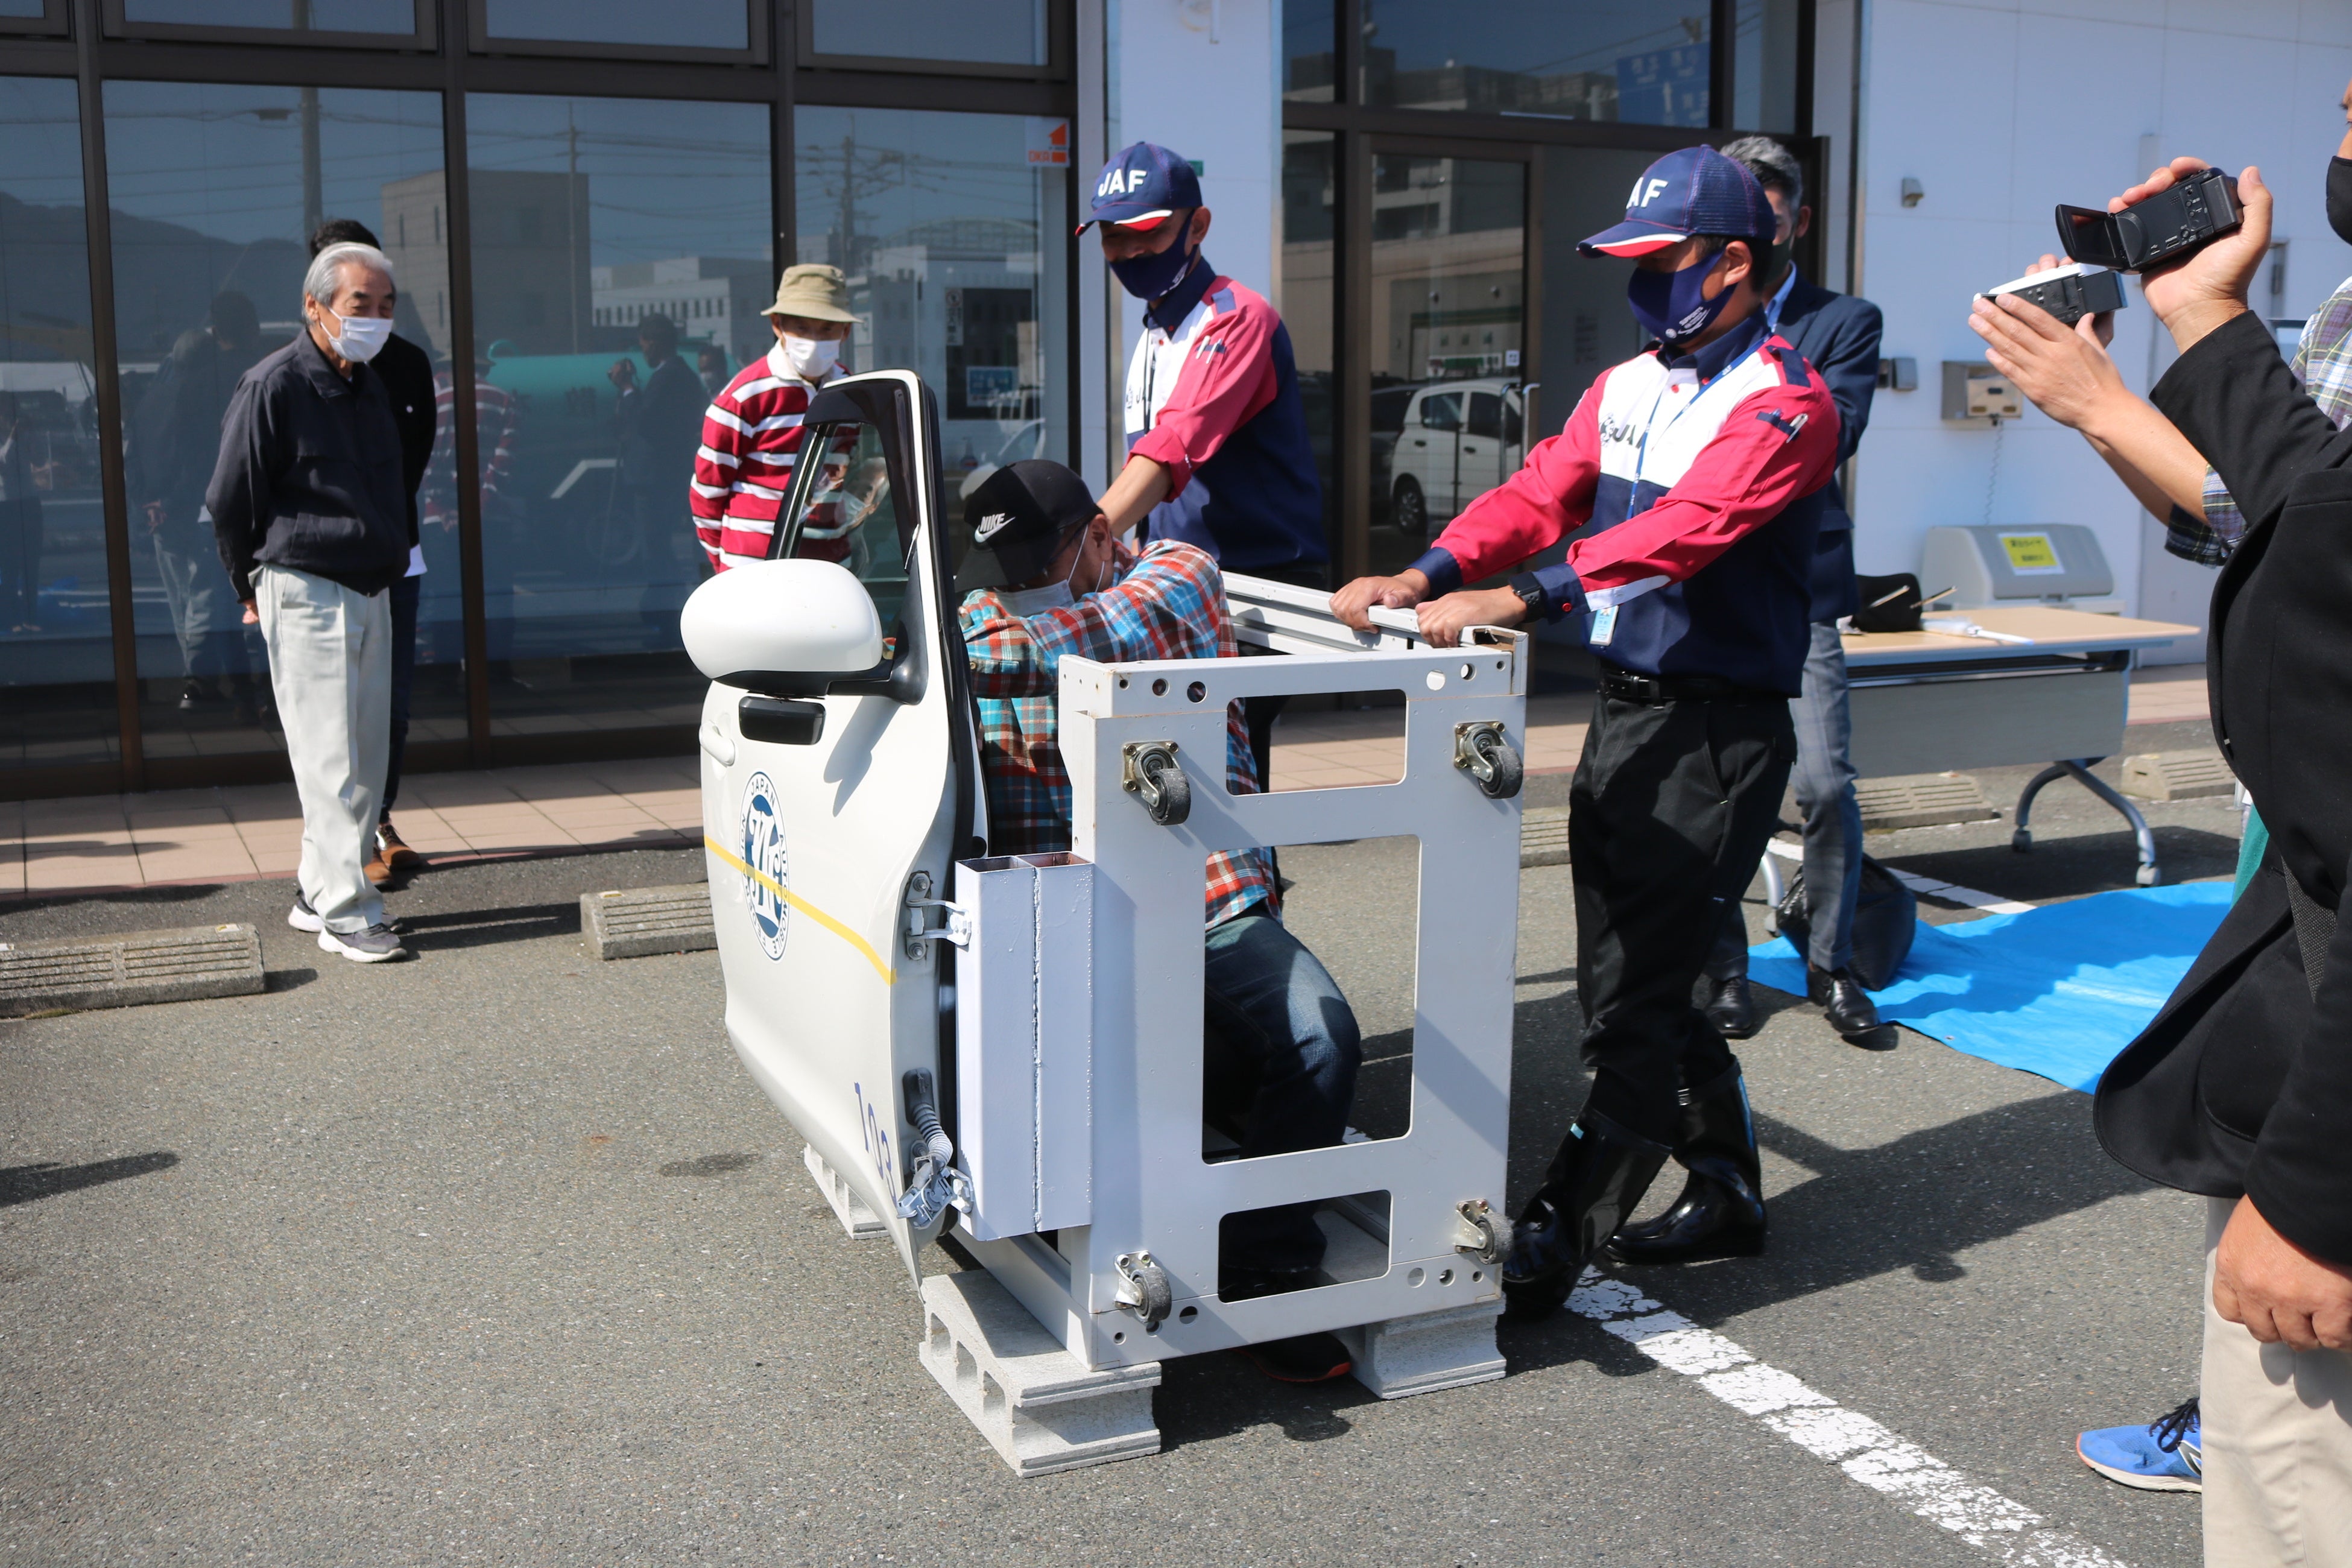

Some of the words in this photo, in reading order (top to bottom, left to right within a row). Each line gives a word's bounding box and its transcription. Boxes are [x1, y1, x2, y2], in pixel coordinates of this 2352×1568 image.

[1097, 168, 1147, 197] JAF
[1625, 177, 1669, 209] AF
[979, 513, 1005, 532] NIKE
[751, 778, 776, 808] JAPAN
[773, 833, 788, 954] AUTOMOBILE
[853, 1081, 898, 1208] 103
